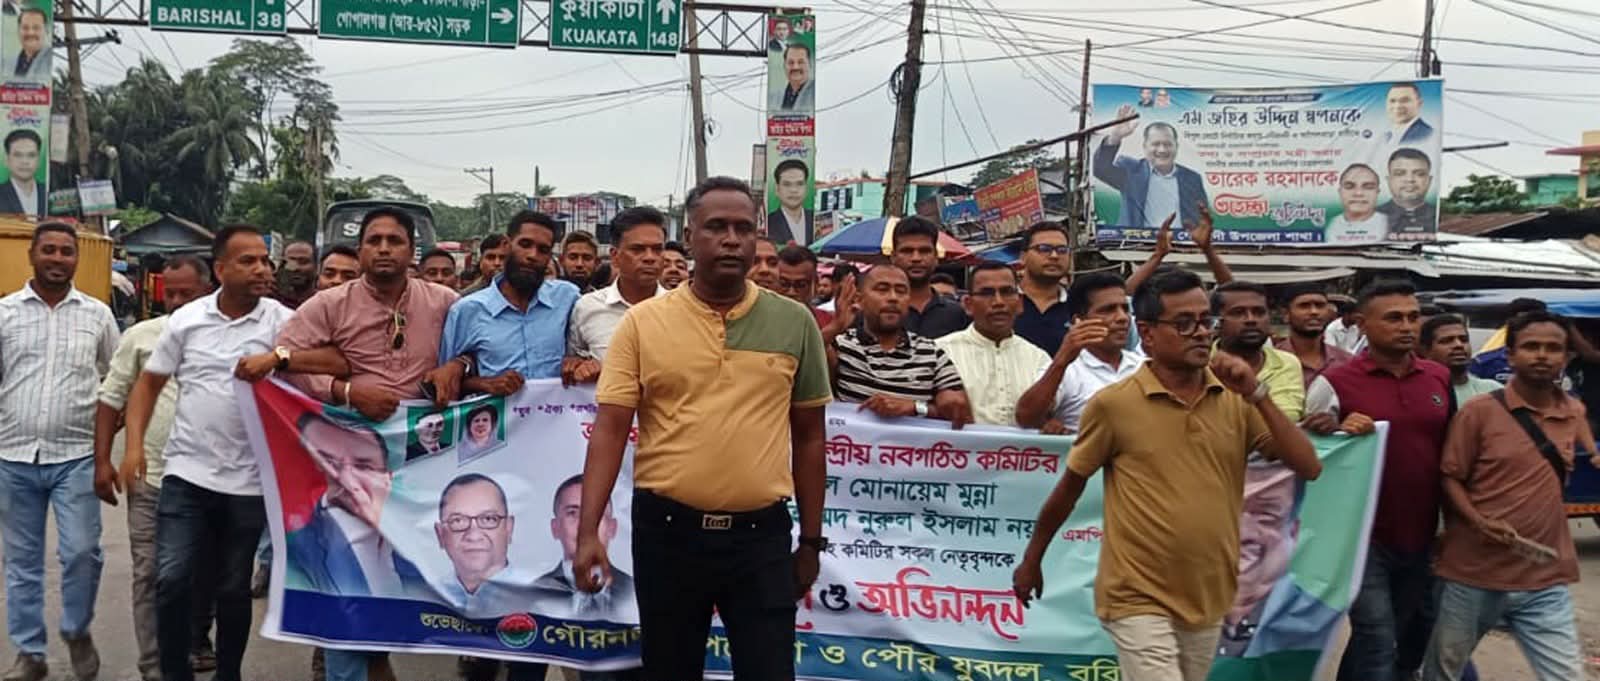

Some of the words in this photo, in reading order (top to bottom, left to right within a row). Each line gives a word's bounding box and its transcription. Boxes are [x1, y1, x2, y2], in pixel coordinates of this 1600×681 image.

[157, 7, 245, 26] BARISHAL
[257, 12, 282, 28] 38
[336, 11, 387, 30] গোপালগঞ্জ
[446, 17, 472, 38] সড়ক
[562, 28, 638, 46] KUAKATA
[651, 32, 678, 47] 148
[1178, 109, 1202, 125] এম
[1208, 106, 1248, 127] জহির
[1254, 106, 1299, 128] উদ্দিন
[1204, 171, 1260, 188] তারেক
[1264, 170, 1341, 189] রহমানকে
[878, 441, 970, 469] নবগঠিত
[976, 445, 1060, 474] কমিটির
[849, 477, 950, 503] মোনায়েম
[956, 481, 998, 509] মুন্না
[856, 508, 916, 536] নুরুল
[921, 508, 1000, 537] ইসলাম
[1006, 516, 1038, 540] নয়
[841, 539, 895, 560] কমিটির
[898, 544, 936, 561] সকল
[940, 549, 1016, 573] নেতৃবৃন্দকে
[819, 583, 850, 612] ও
[854, 566, 1024, 641] অভিনন্দন
[819, 645, 846, 665] ও
[861, 641, 940, 675] পৌর
